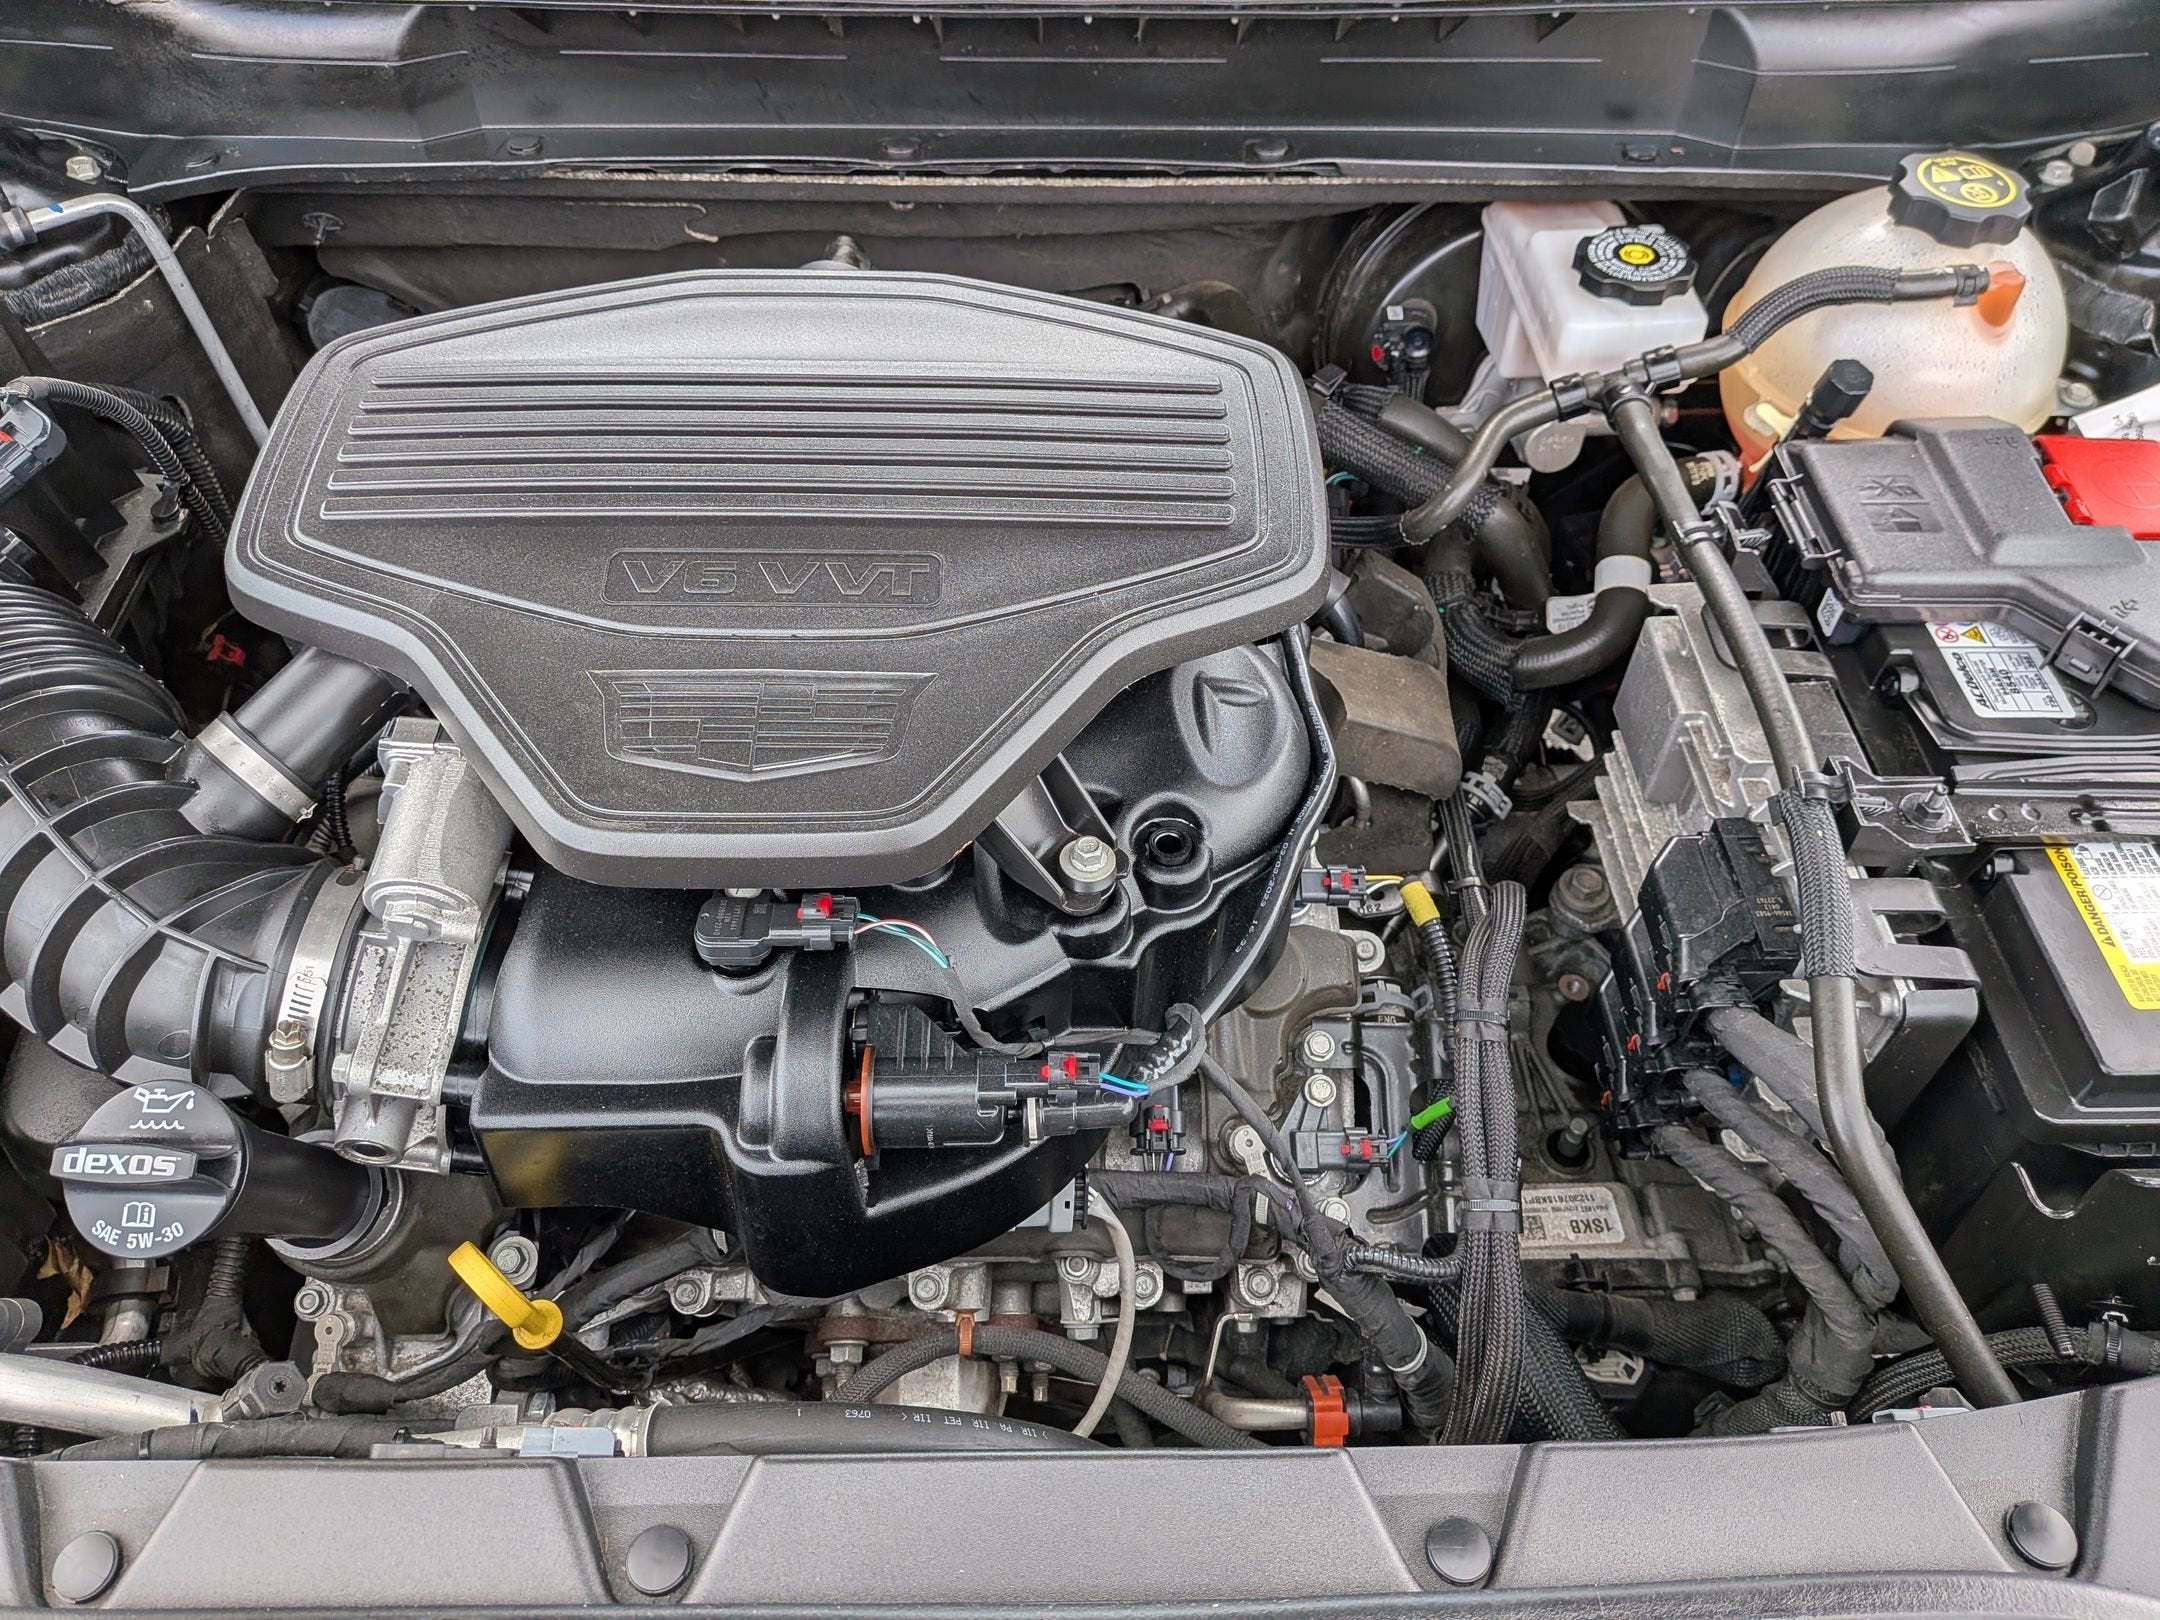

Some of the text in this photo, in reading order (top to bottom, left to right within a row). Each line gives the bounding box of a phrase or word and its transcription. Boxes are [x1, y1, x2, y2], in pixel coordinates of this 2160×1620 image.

[621, 559, 932, 597] V6 VVT
[1951, 651, 1990, 709] ACDelco
[1260, 842, 1289, 908] 03/03/2023
[2052, 847, 2112, 938] DANGER/POISON
[62, 1147, 177, 1177] dexos
[91, 1220, 185, 1249] SAE 5W-30
[1569, 1218, 1614, 1234] 1SKB
[844, 1408, 872, 1419] 0763
[943, 1415, 962, 1425] PET
